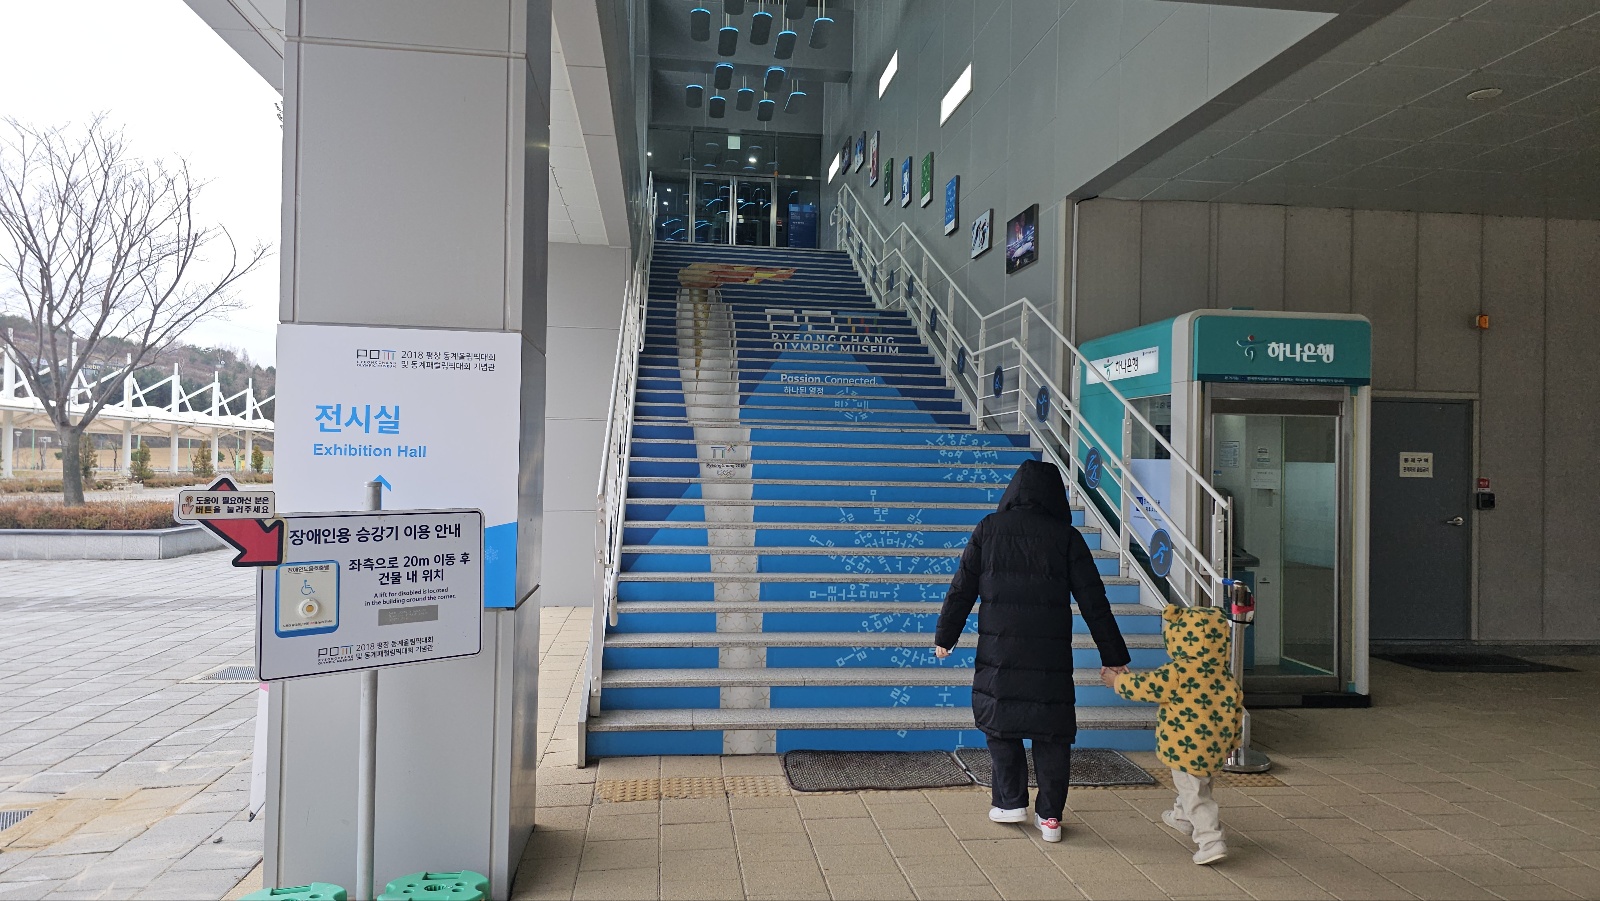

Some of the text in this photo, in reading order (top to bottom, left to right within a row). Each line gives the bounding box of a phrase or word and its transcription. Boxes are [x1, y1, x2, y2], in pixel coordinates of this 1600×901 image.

[401, 351, 424, 359] 2018
[1267, 341, 1334, 363] 하나은행
[780, 374, 878, 385] Passion. Connected.
[784, 386, 824, 395] 하나된 열정
[314, 403, 400, 435] 전시실
[313, 443, 427, 458] Exhibition Hall
[289, 523, 461, 546] 장애인용 승강기 이용 안내
[348, 552, 471, 572] 좌측으로 20m 이동 후
[378, 568, 444, 585] 건물 내 위치
[382, 596, 405, 605] building
[356, 643, 374, 652] 2018
